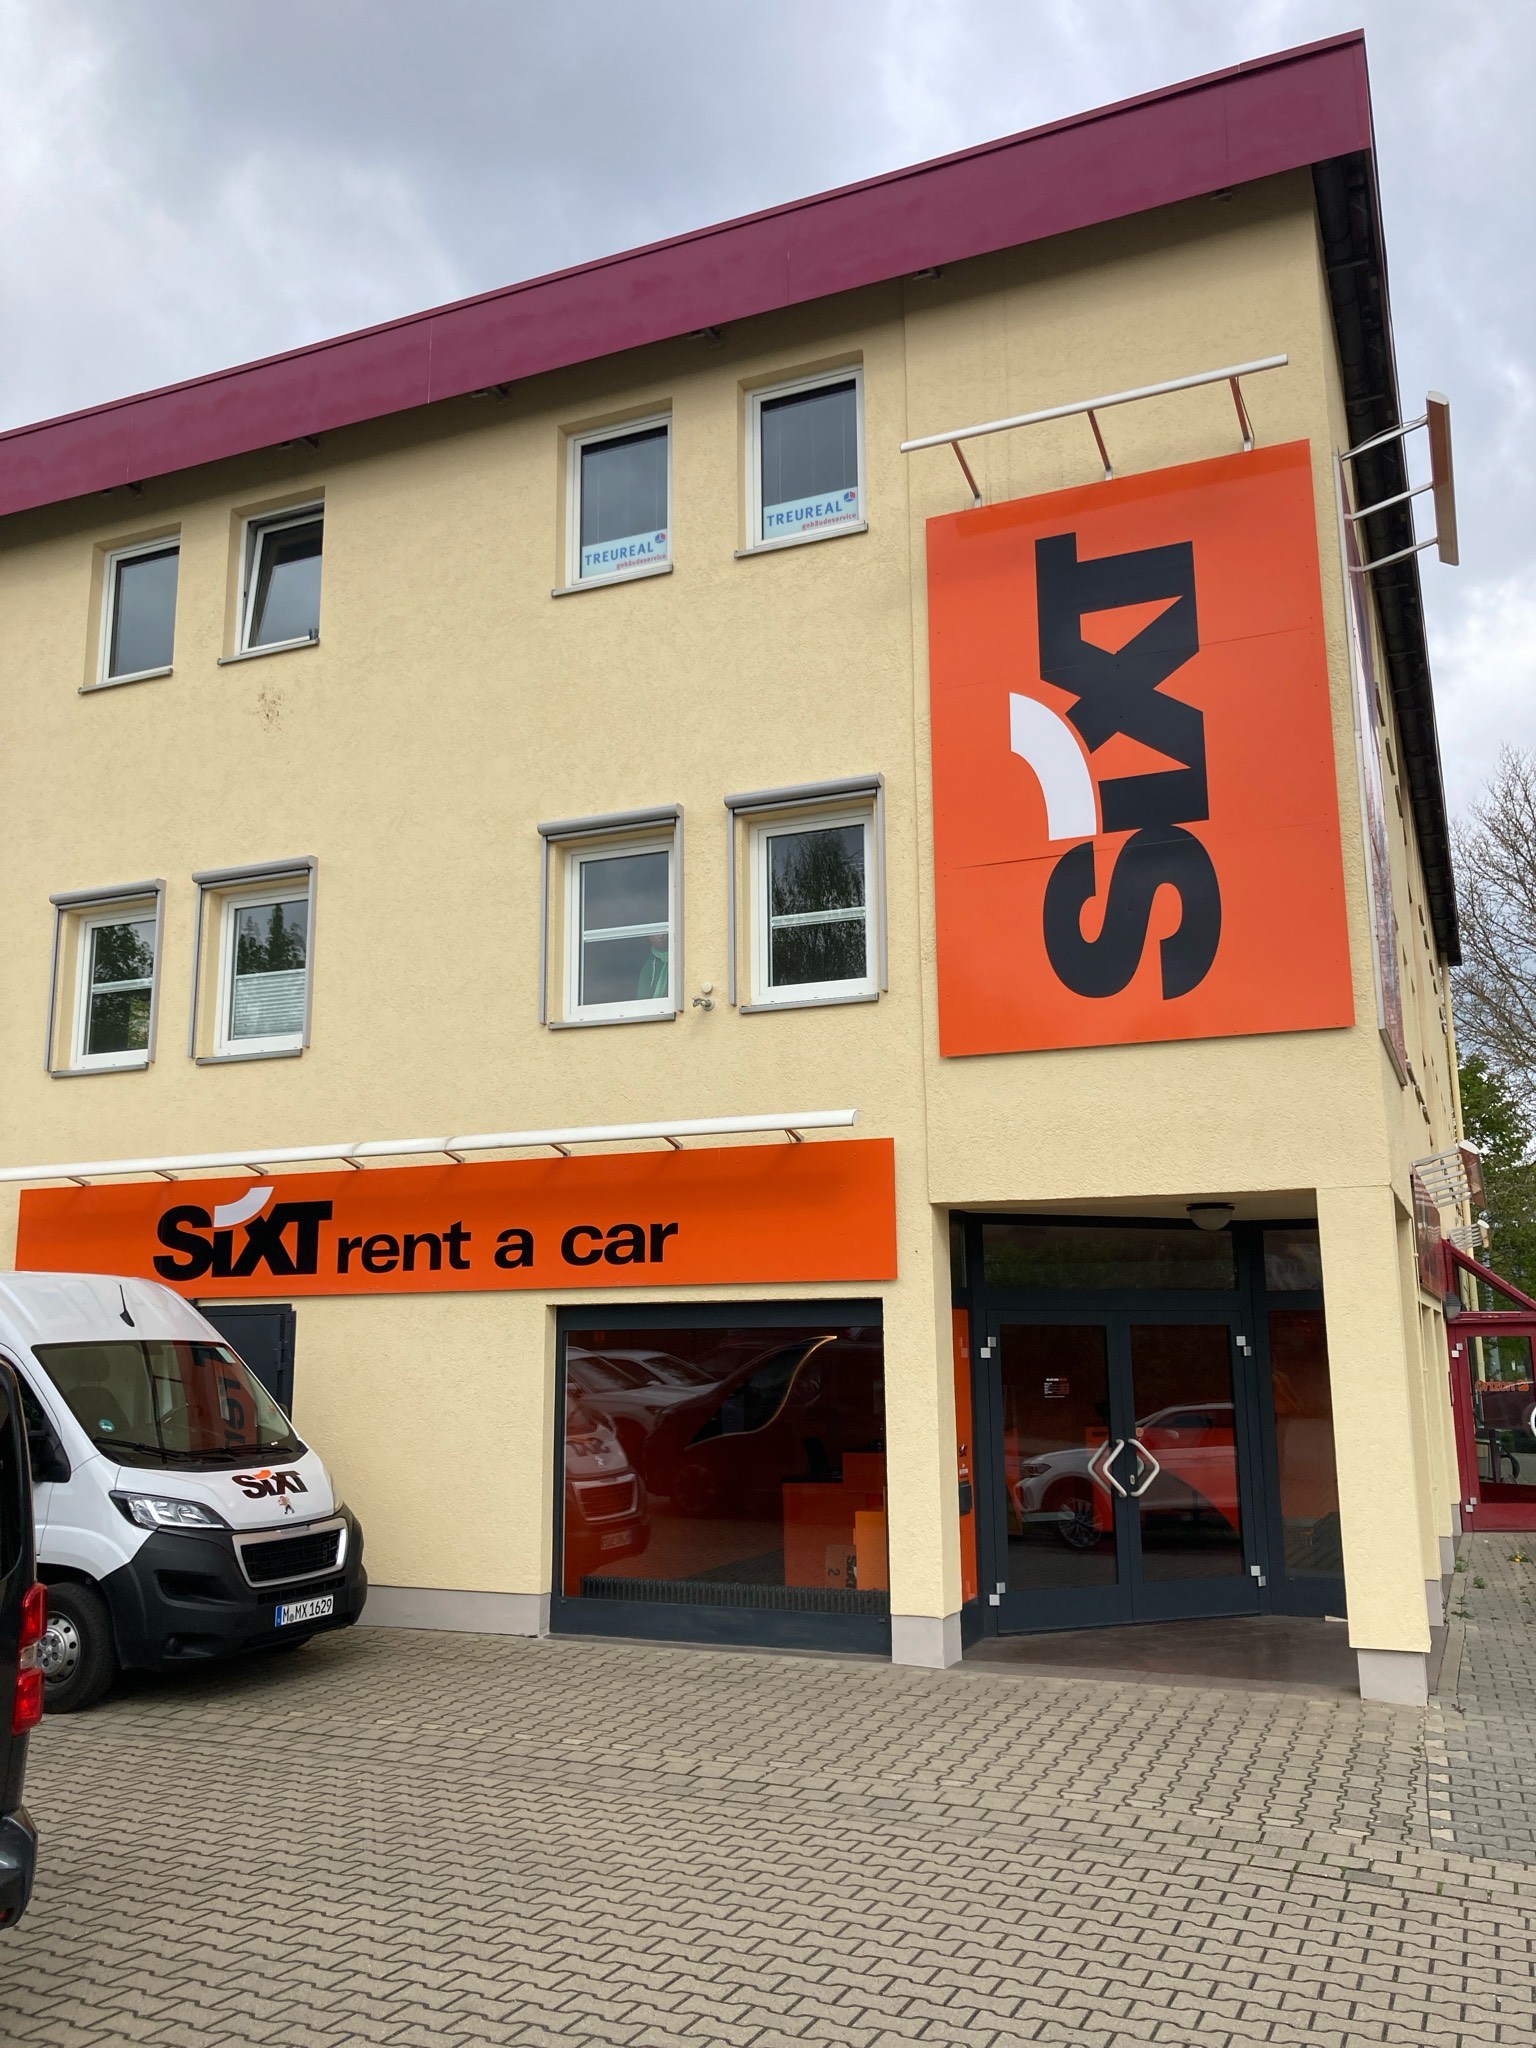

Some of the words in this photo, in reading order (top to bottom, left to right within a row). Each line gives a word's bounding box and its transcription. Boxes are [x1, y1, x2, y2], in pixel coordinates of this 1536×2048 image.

[767, 500, 843, 527] TREUREAL
[801, 513, 857, 531] gebäudeservice
[585, 541, 654, 566] TREUREAL
[616, 554, 666, 571] gebäudeservice
[337, 1220, 472, 1274] rent
[494, 1228, 534, 1270] a
[561, 1222, 679, 1267] car
[309, 1598, 333, 1617] 1629
